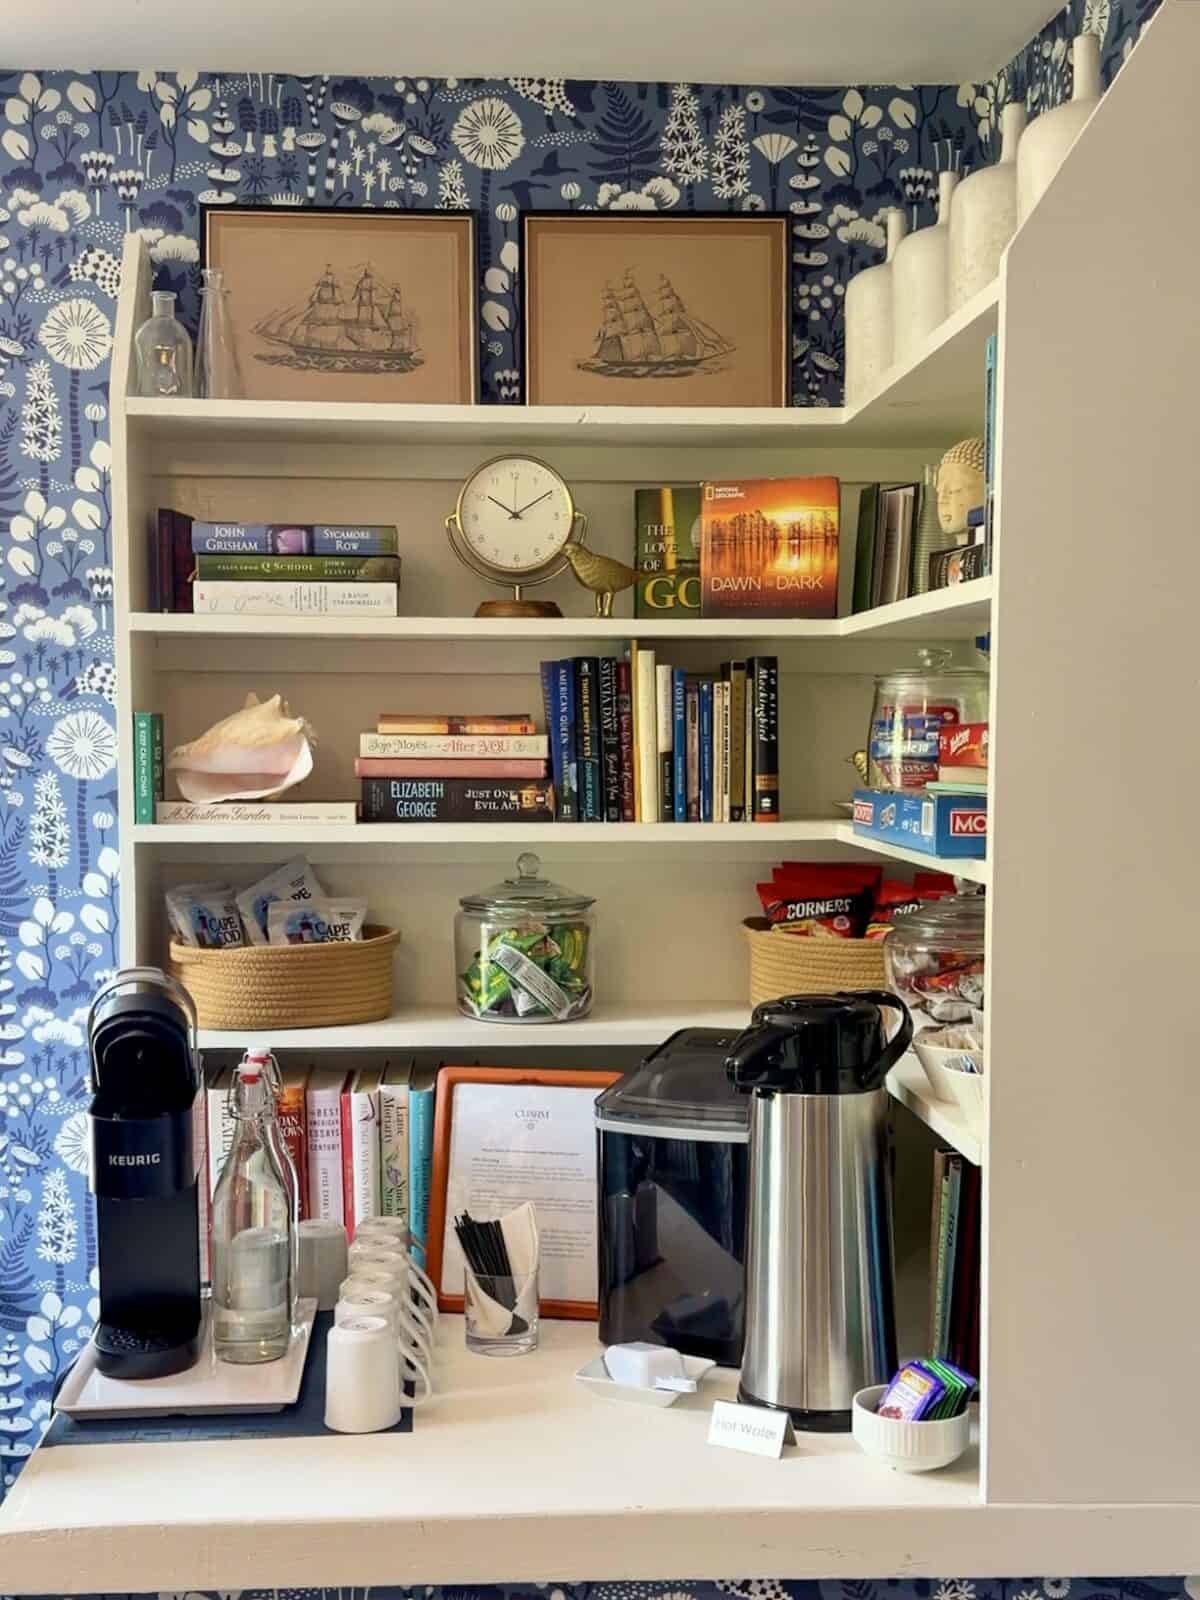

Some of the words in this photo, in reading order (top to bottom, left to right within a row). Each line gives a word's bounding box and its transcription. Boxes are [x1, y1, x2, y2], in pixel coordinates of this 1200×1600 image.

[214, 526, 245, 538] JOHN
[323, 528, 371, 539] SYCAMORE
[643, 524, 673, 536] THE
[205, 538, 258, 551] GRISHAM
[335, 540, 359, 551] ROW
[643, 544, 677, 553] LOVE
[261, 560, 271, 573] Q
[273, 561, 313, 572] SCHOOL
[643, 559, 661, 572] OF
[711, 576, 761, 592] DAWN
[776, 574, 824, 591] DARK
[559, 668, 569, 713] AMERICAN
[600, 660, 612, 705] SYLVIA
[755, 667, 769, 742] Mockingbird
[602, 706, 613, 730] DAY
[559, 715, 569, 745] QUEEN
[584, 735, 592, 757] EYES
[391, 781, 444, 799] ELIZABETH
[464, 789, 492, 799] JUST
[493, 789, 515, 799] ONE
[396, 800, 437, 818] GEORGE
[474, 801, 499, 810] EVIL
[501, 801, 521, 811] ACT
[291, 887, 312, 902] PE
[786, 899, 852, 920] CORNERS
[209, 916, 237, 933] CAPE
[315, 921, 351, 937] CAPE
[383, 1098, 395, 1144] Moriarty
[396, 1105, 407, 1136] Liane
[108, 1153, 161, 1166] KEURIG
